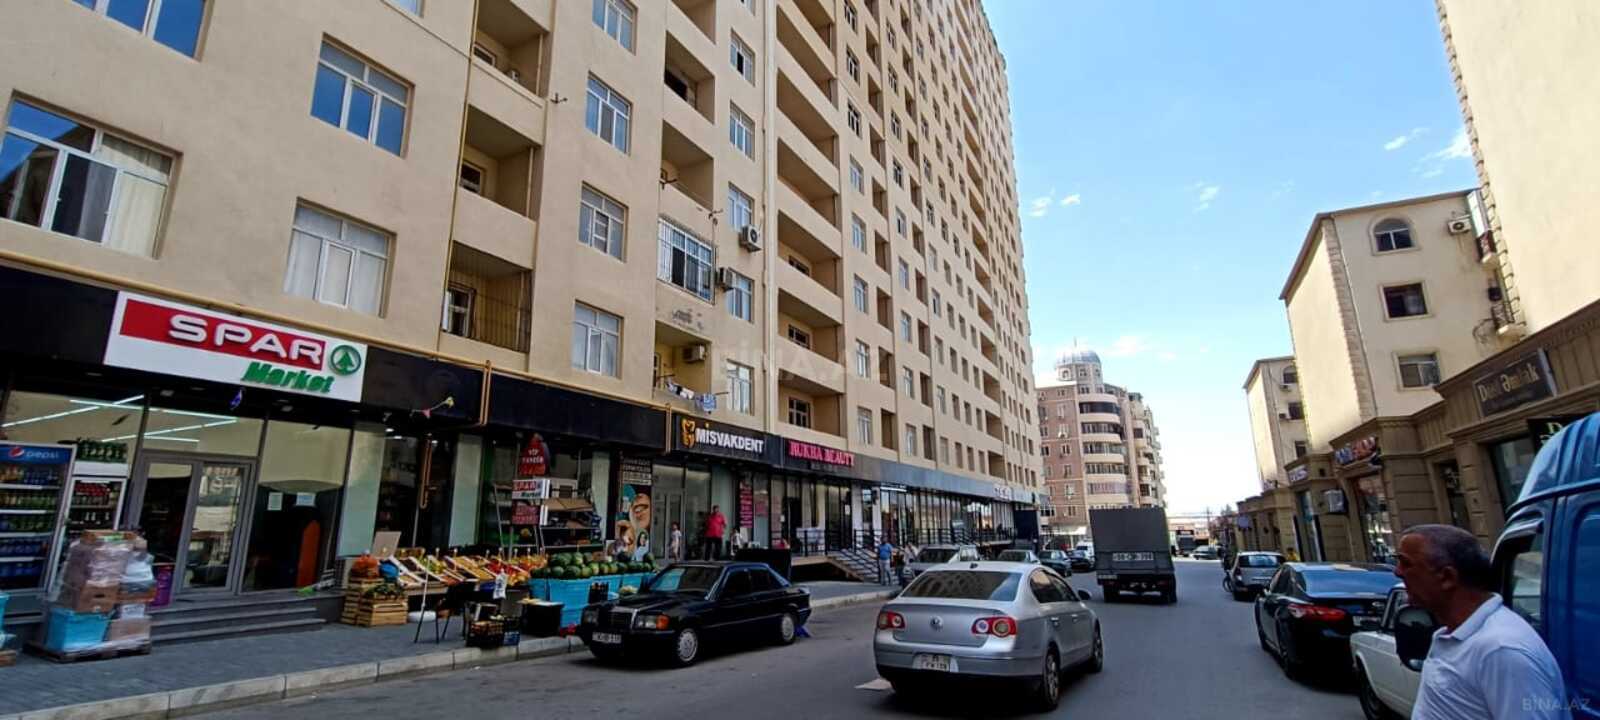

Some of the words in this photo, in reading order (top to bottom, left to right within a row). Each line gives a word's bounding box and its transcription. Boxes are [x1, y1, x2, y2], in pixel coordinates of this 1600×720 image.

[168, 314, 322, 364] SPAR
[241, 361, 335, 393] Market
[26, 451, 59, 460] pepsi
[824, 449, 856, 467] BEAUTY
